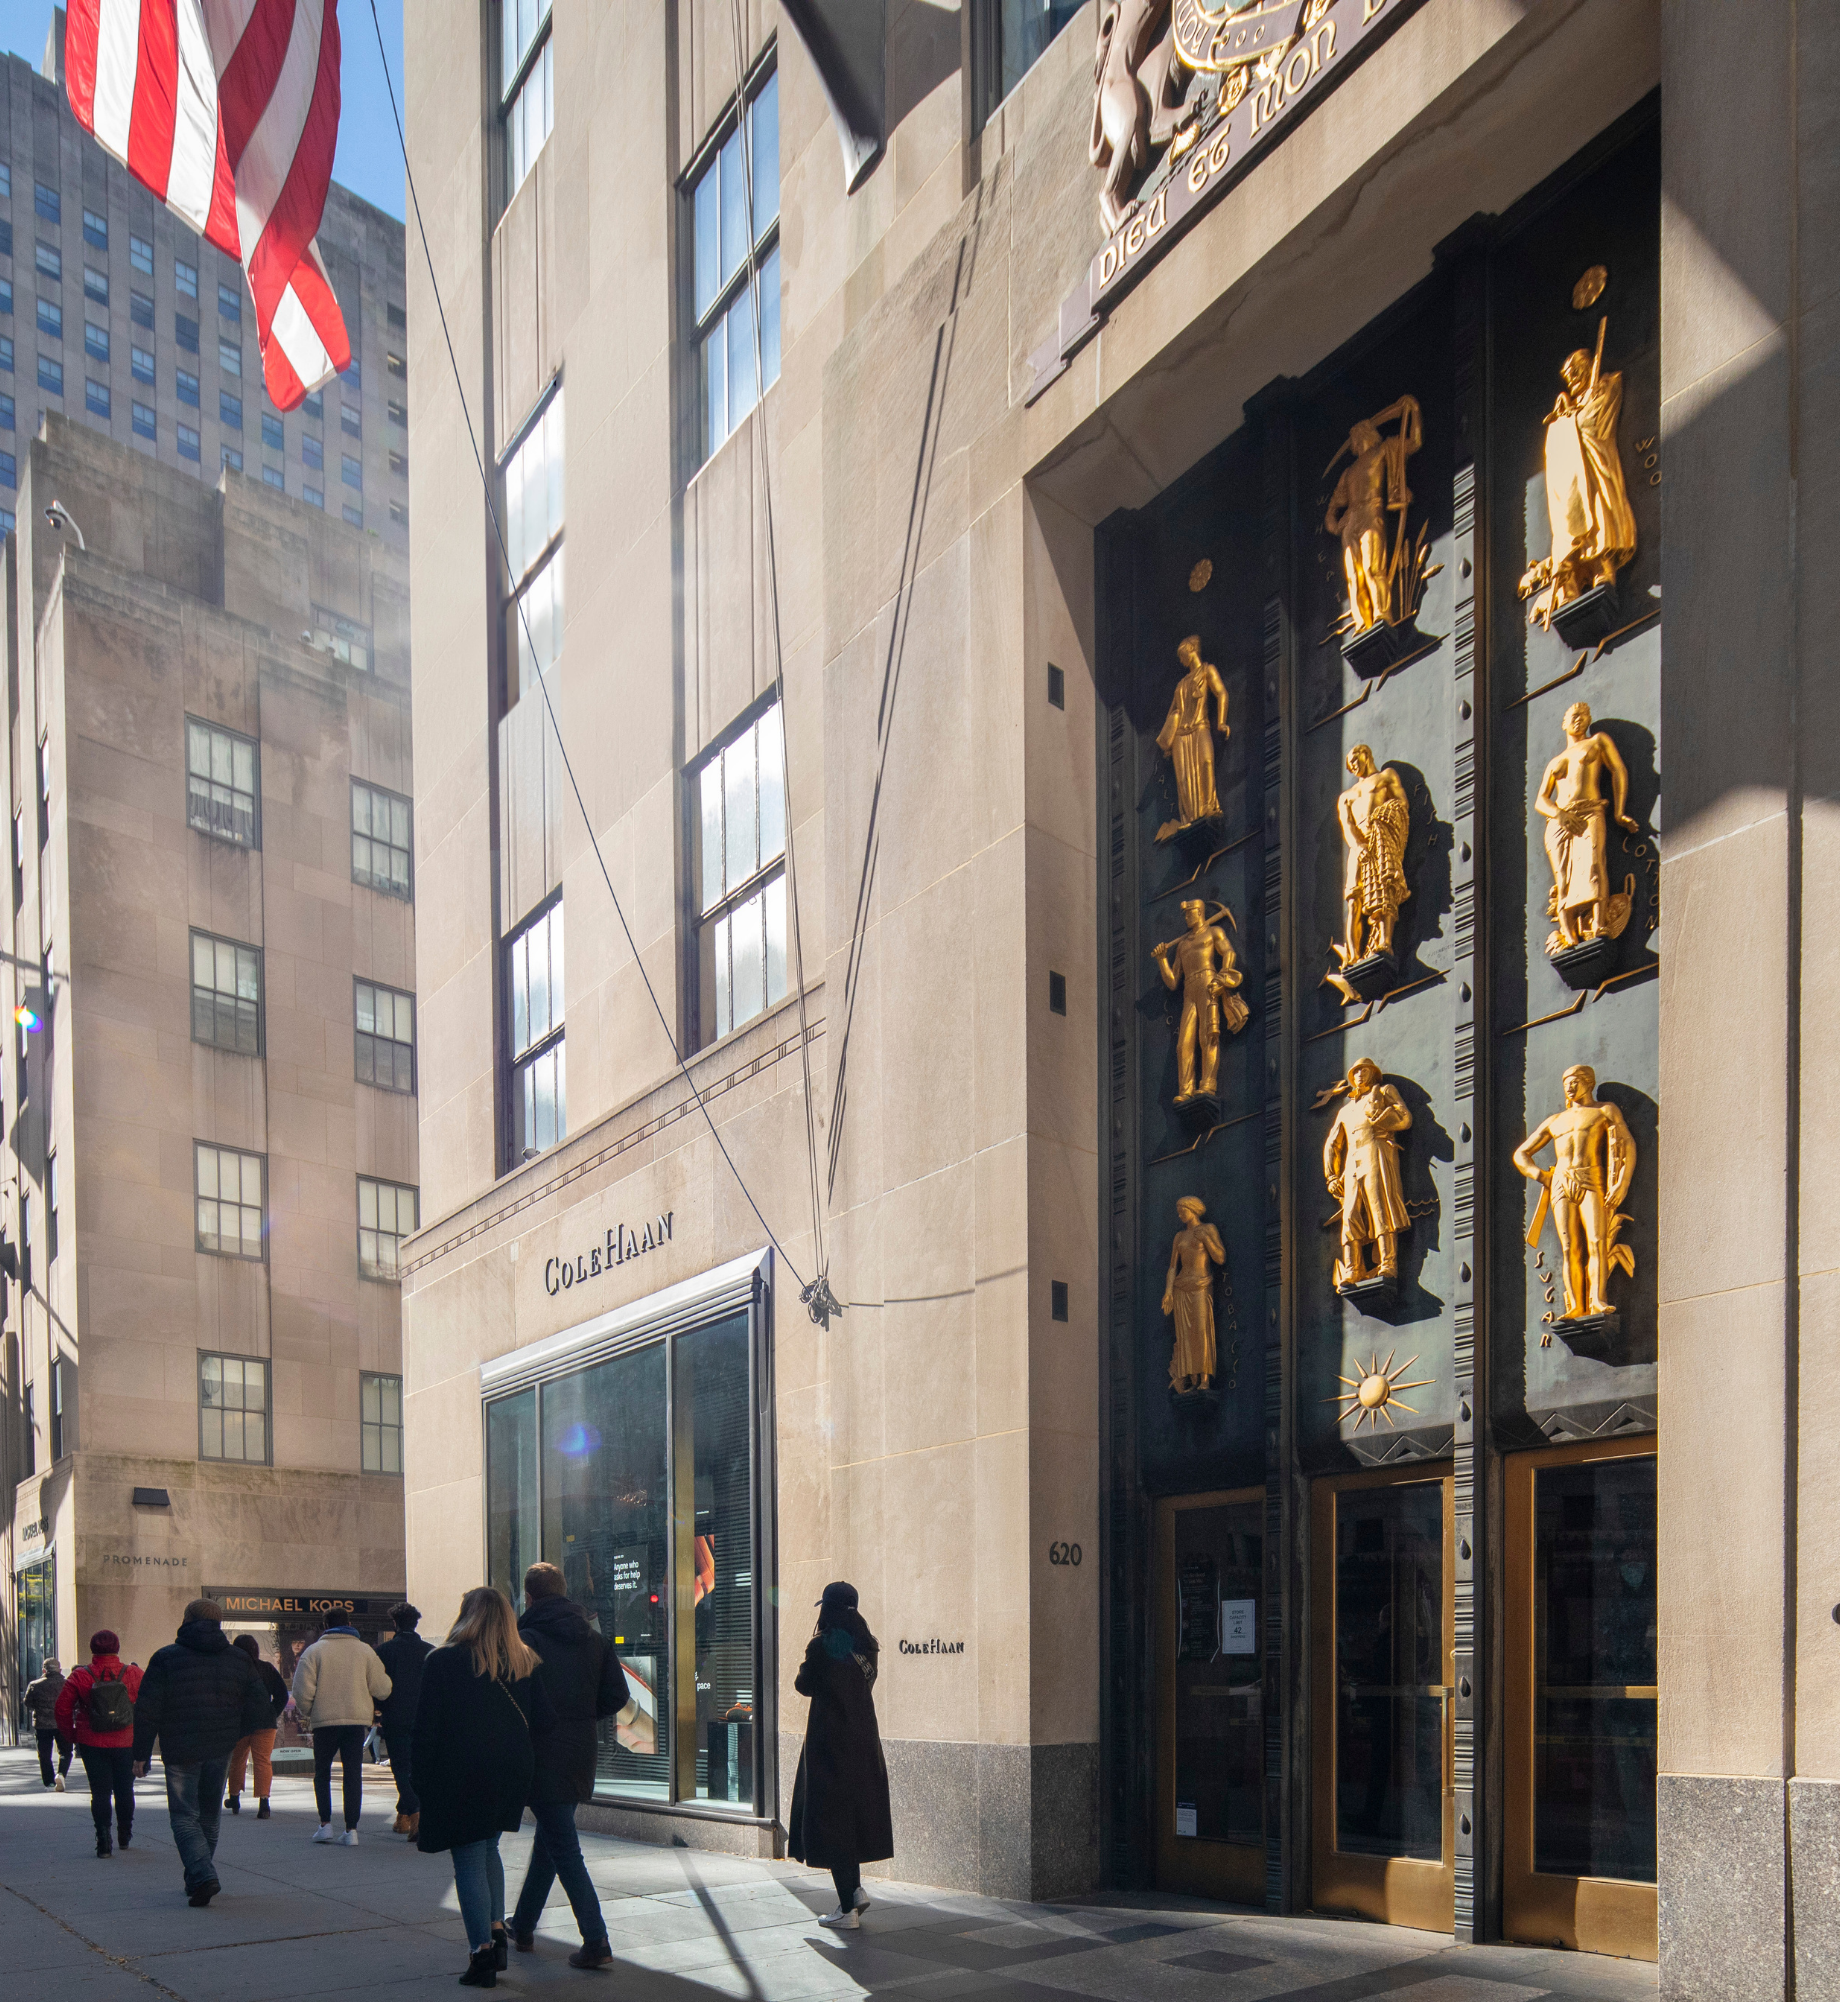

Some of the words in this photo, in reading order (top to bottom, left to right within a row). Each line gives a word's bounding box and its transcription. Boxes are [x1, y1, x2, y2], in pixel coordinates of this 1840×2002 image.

[1153, 760, 1176, 813] SALT
[1413, 783, 1438, 847] FISH
[1622, 836, 1659, 930] COTTON
[1534, 1250, 1555, 1348] SUGAR
[1221, 1272, 1239, 1389] TOBACCO
[103, 1554, 188, 1567] PROMENADE
[614, 1562, 629, 1572] Anyone
[629, 1560, 639, 1569] who
[1049, 1541, 1082, 1566] 620
[614, 1572, 623, 1581] asks
[630, 1570, 641, 1580] help
[226, 1597, 303, 1612] MICHAEL
[309, 1599, 355, 1613] KORS
